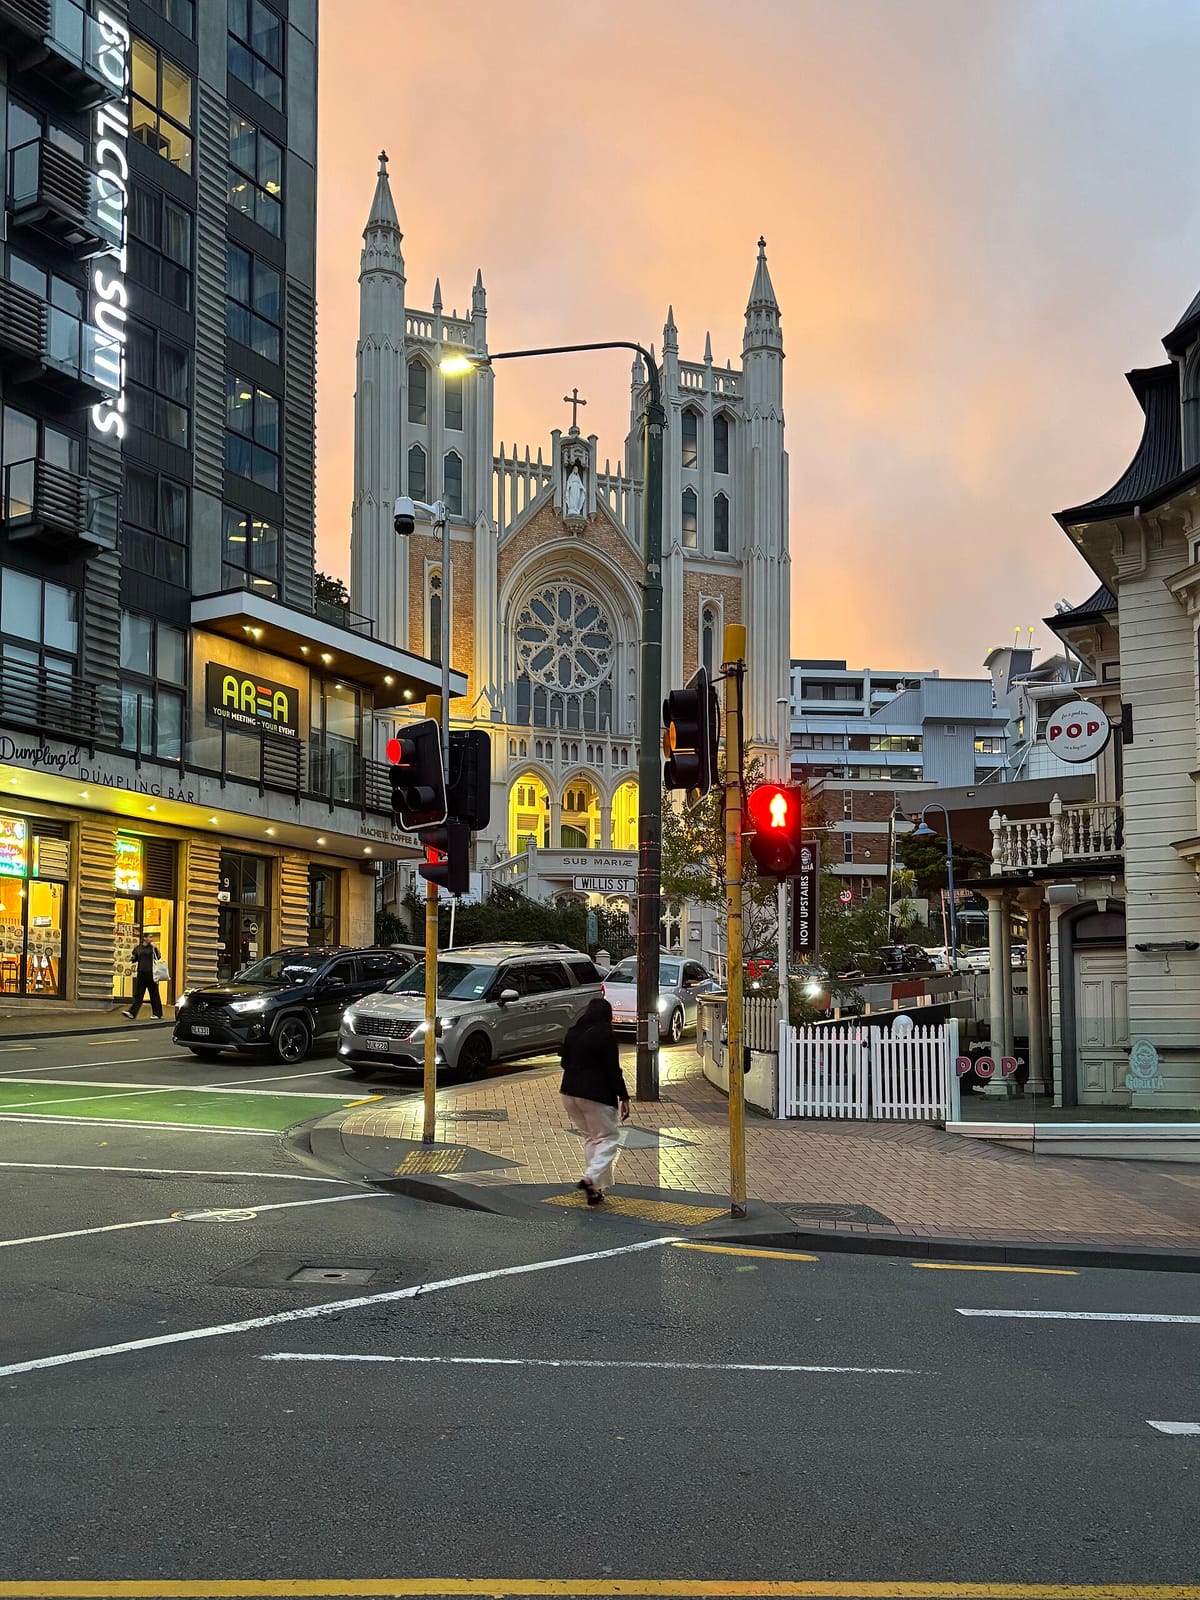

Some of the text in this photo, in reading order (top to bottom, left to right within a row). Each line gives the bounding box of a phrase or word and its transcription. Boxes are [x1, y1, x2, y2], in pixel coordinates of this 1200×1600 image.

[222, 675, 289, 724] AREA
[212, 706, 231, 718] YOUR
[231, 712, 256, 726] MEETING
[261, 720, 278, 733] YOUR
[278, 725, 296, 737] EVENT
[1050, 721, 1100, 741] POP
[80, 768, 195, 804] DUMPLING BAR
[390, 832, 413, 845] COFFEE
[563, 857, 588, 866] SUB
[223, 877, 230, 888] 9
[581, 877, 630, 891] WILLIS ST
[800, 875, 809, 918] UPSTAIRS
[800, 920, 809, 946] NOW
[955, 1056, 1018, 1078] POP
